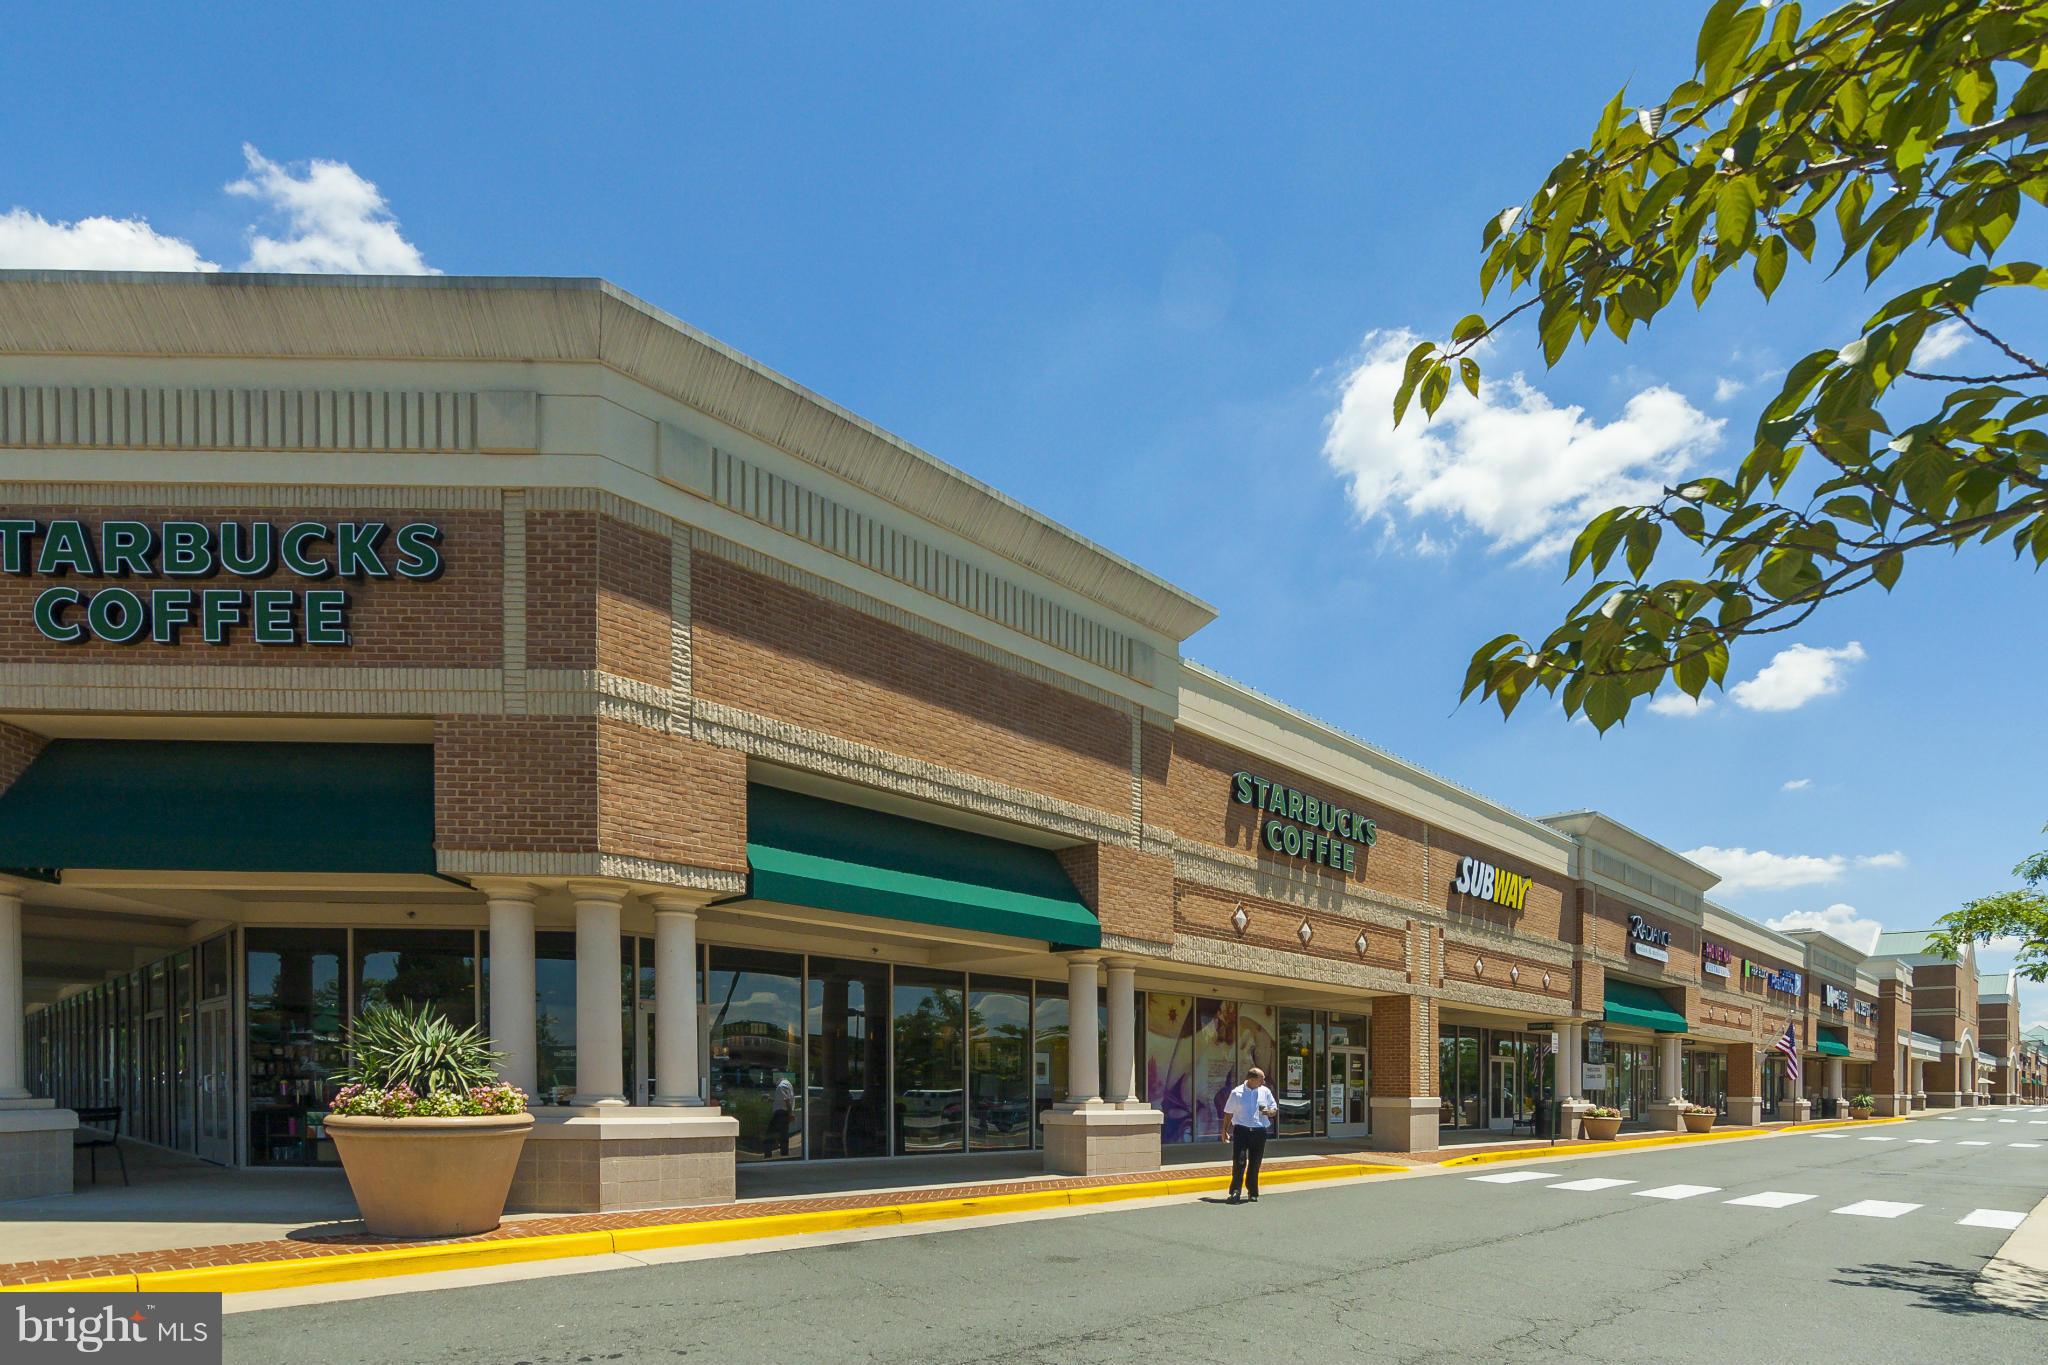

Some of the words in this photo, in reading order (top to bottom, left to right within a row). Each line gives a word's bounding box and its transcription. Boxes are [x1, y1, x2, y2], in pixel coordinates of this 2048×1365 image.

[0, 519, 443, 578] TARBUCKS
[32, 586, 348, 643] COFFEE
[1234, 771, 1377, 847] STARBUCKS
[1265, 819, 1356, 873] COFFEE
[1455, 856, 1534, 910] SUBWAY
